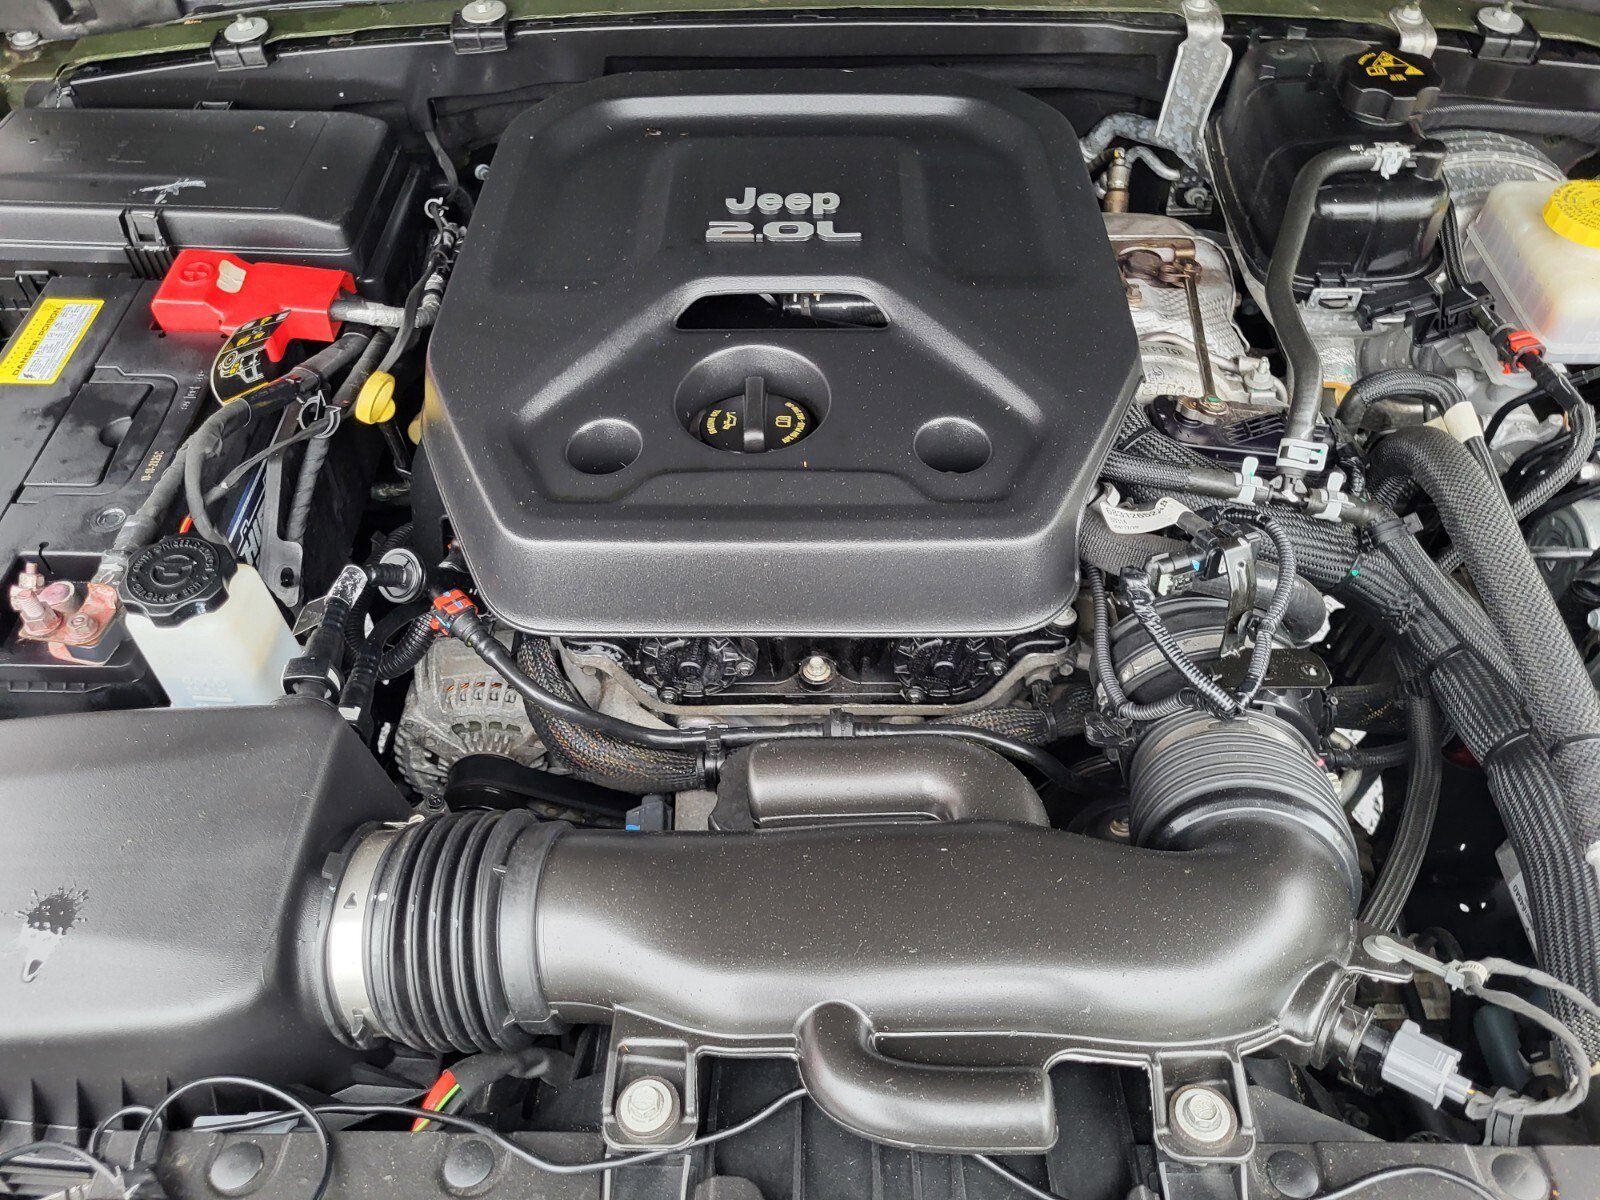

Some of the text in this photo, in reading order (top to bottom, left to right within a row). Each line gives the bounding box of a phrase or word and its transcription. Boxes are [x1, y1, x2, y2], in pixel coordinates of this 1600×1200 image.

[725, 187, 841, 219] Jeep
[705, 221, 863, 243] 2.0L
[12, 339, 40, 376] DANGER
[38, 306, 62, 336] POISON
